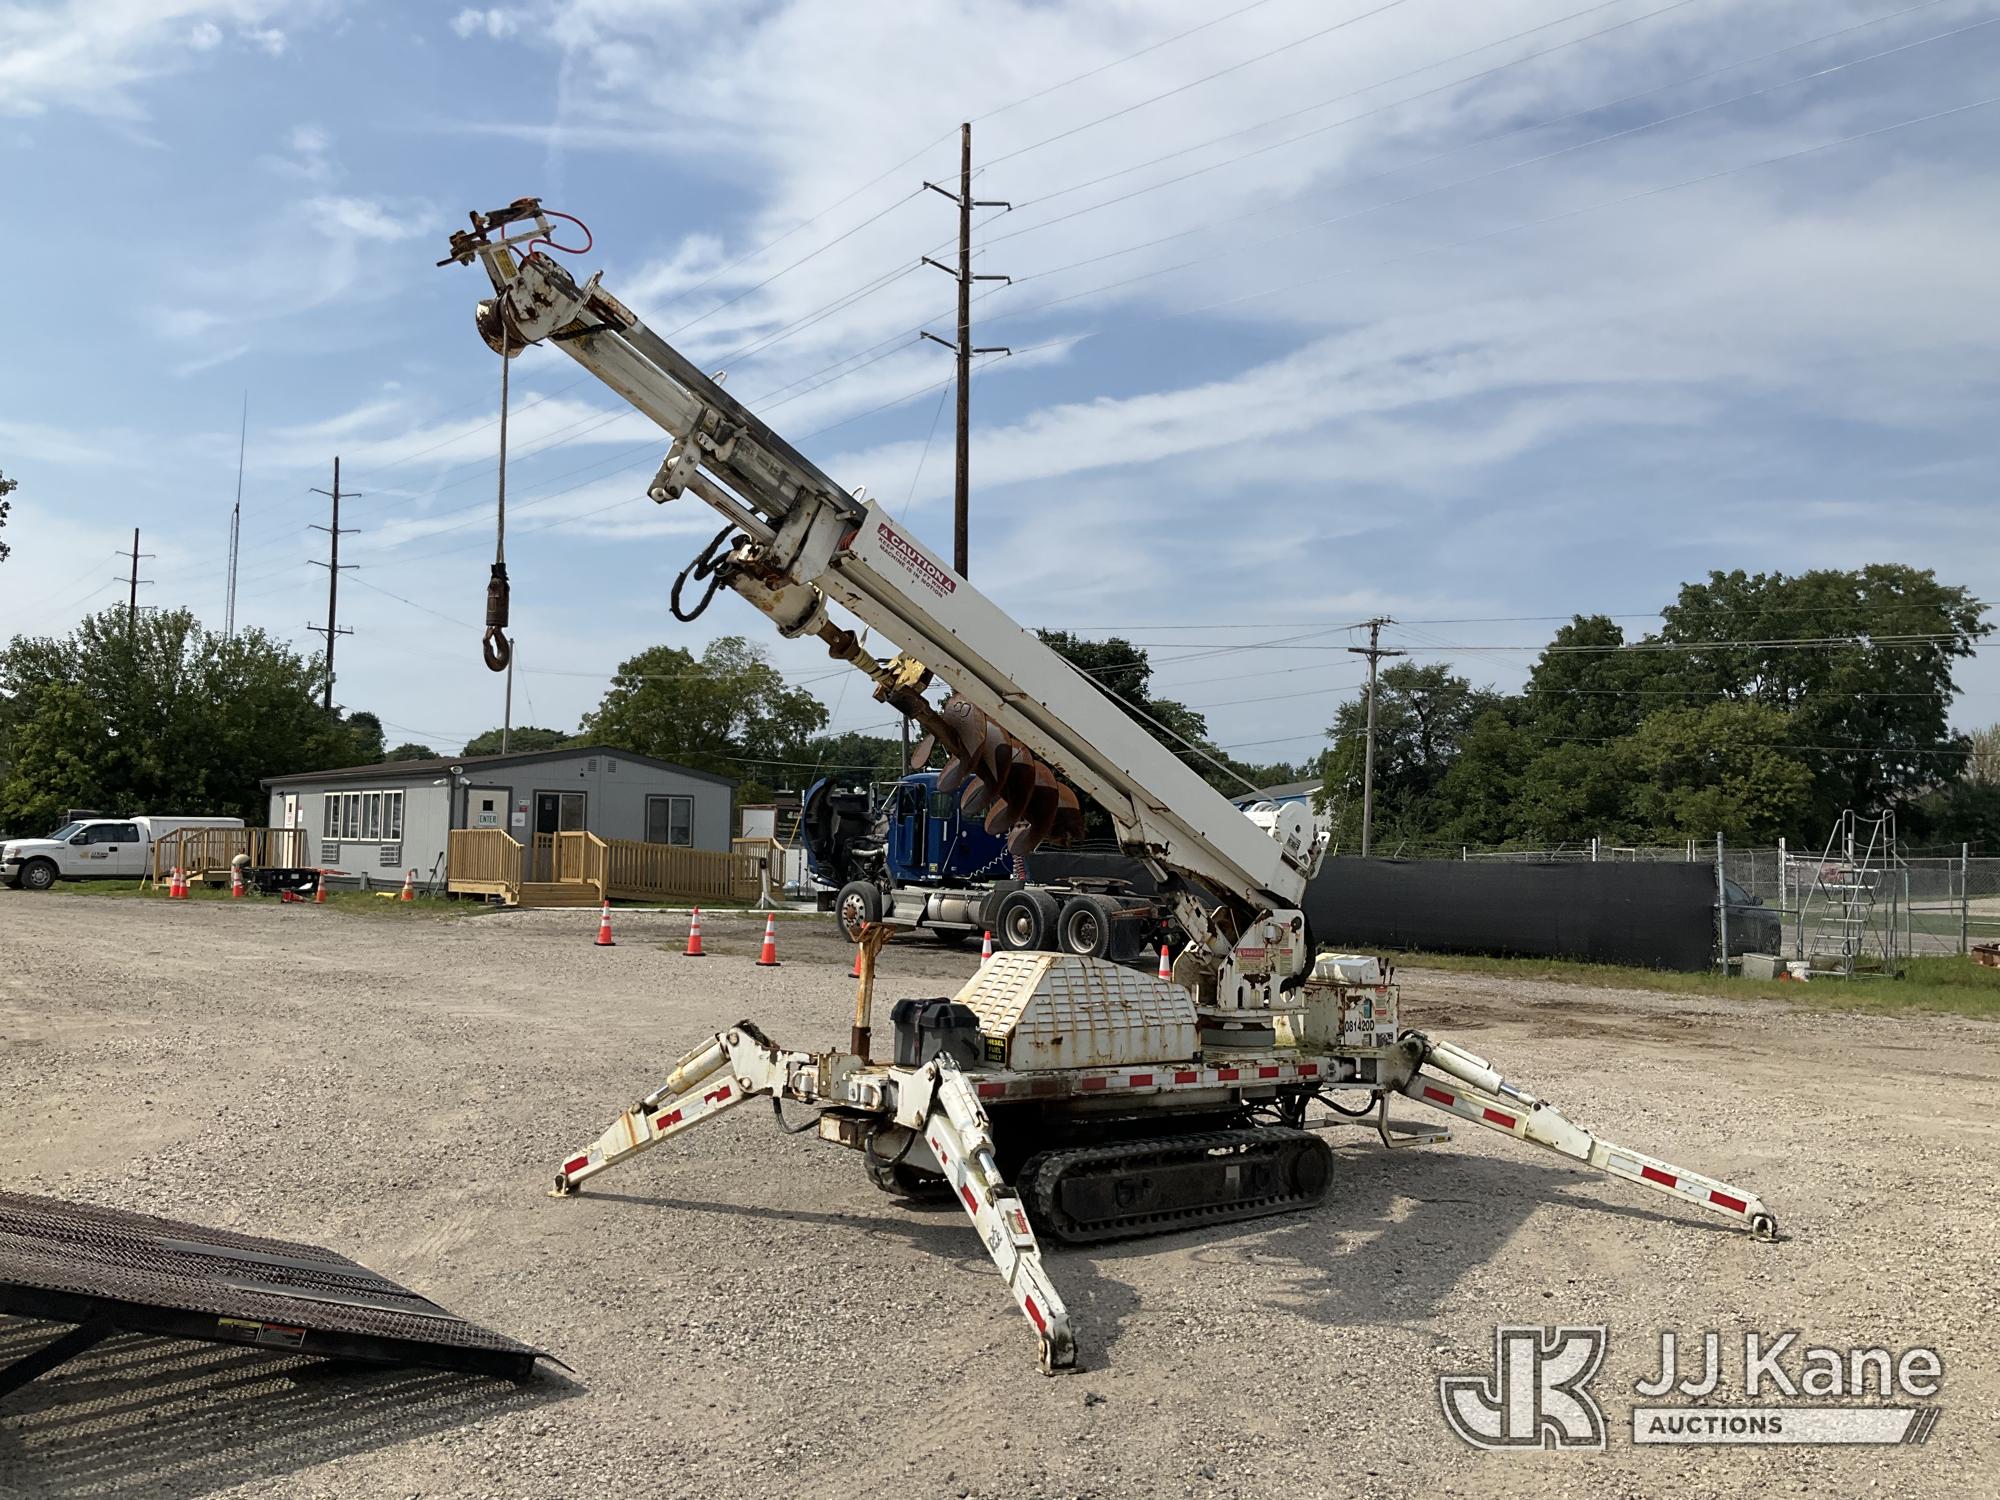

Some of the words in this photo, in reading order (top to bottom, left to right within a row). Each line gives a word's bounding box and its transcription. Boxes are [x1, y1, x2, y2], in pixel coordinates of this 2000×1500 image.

[878, 537, 895, 553] KEEP
[895, 550, 915, 568] CLEAR
[916, 566, 922, 574] 10
[931, 580, 949, 596] WHEN
[879, 544, 906, 568] MACHINE
[920, 577, 943, 599] MOTION
[890, 535, 944, 582] CAUTION
[479, 815, 497, 824] ENTER
